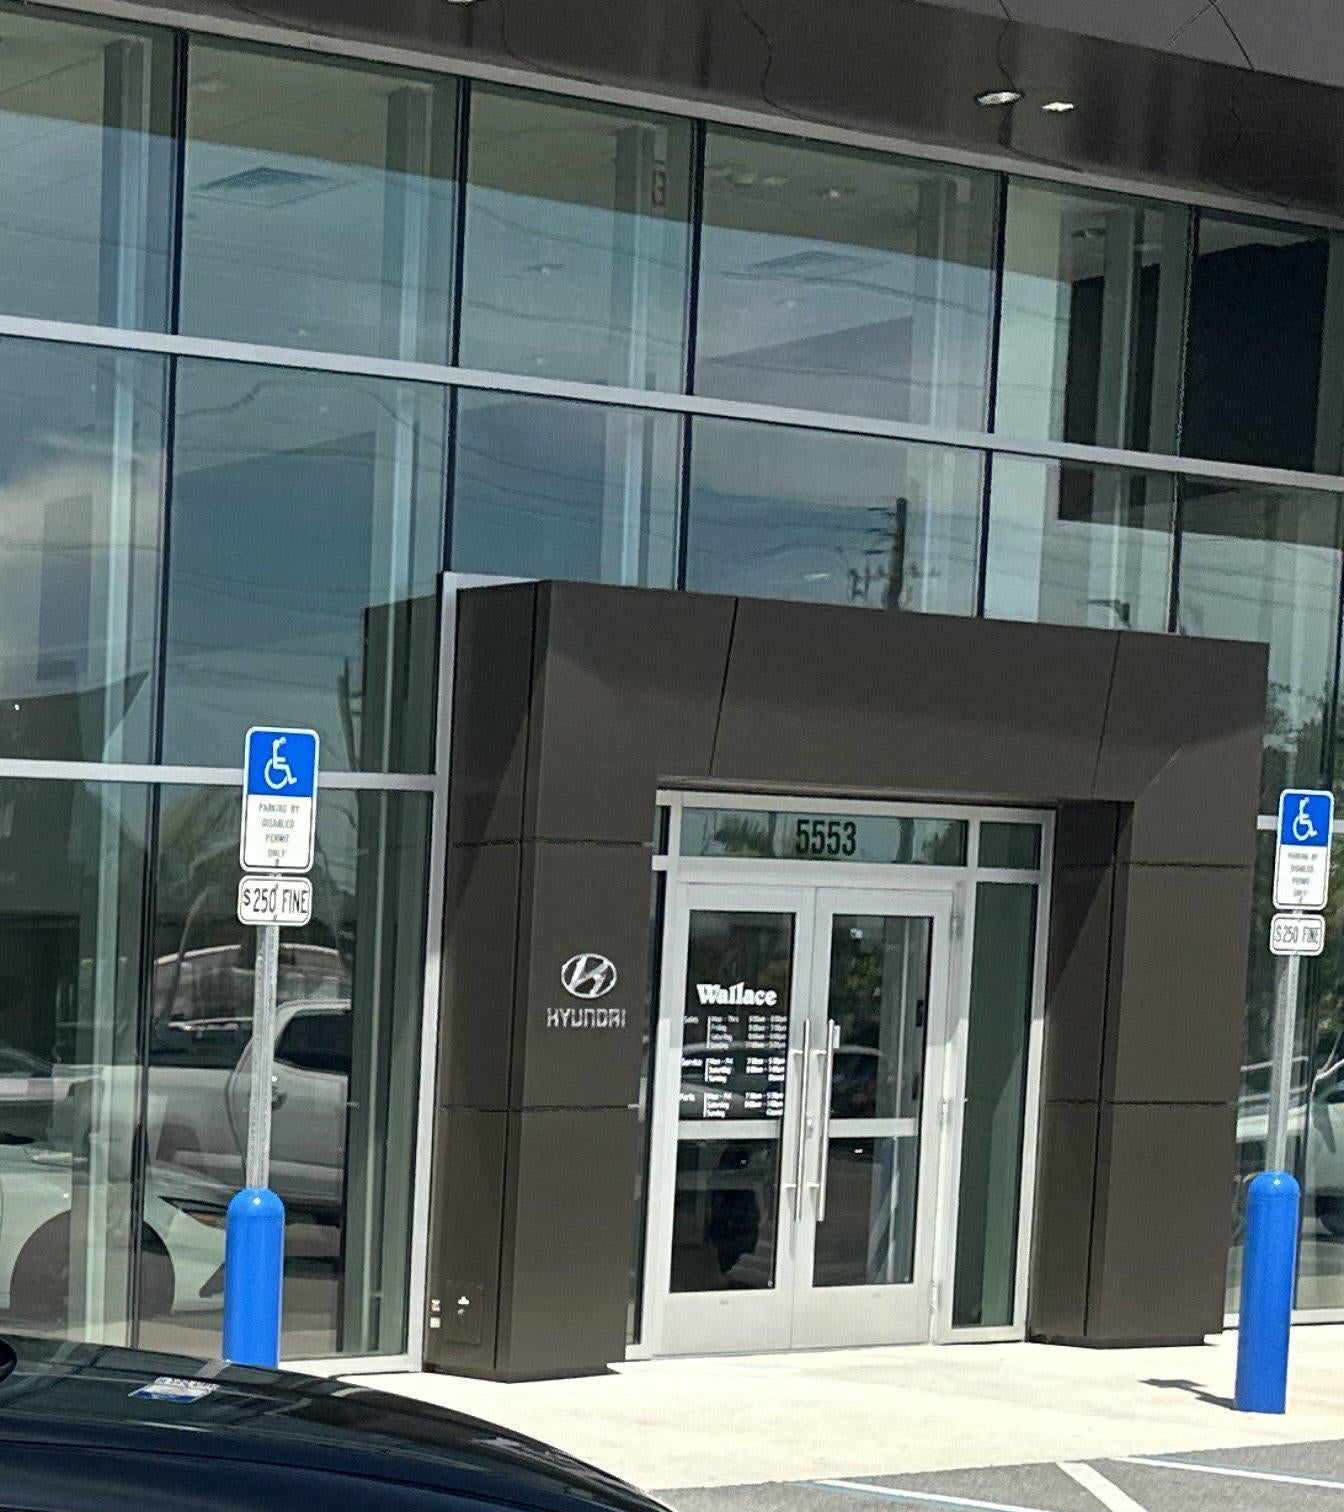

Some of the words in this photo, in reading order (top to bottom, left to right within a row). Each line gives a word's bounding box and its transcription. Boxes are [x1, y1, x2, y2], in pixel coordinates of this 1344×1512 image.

[796, 819, 857, 856] 5553
[282, 889, 308, 914] FINE
[696, 982, 778, 1006] Wallace
[546, 1007, 626, 1028] HYUNDAI
